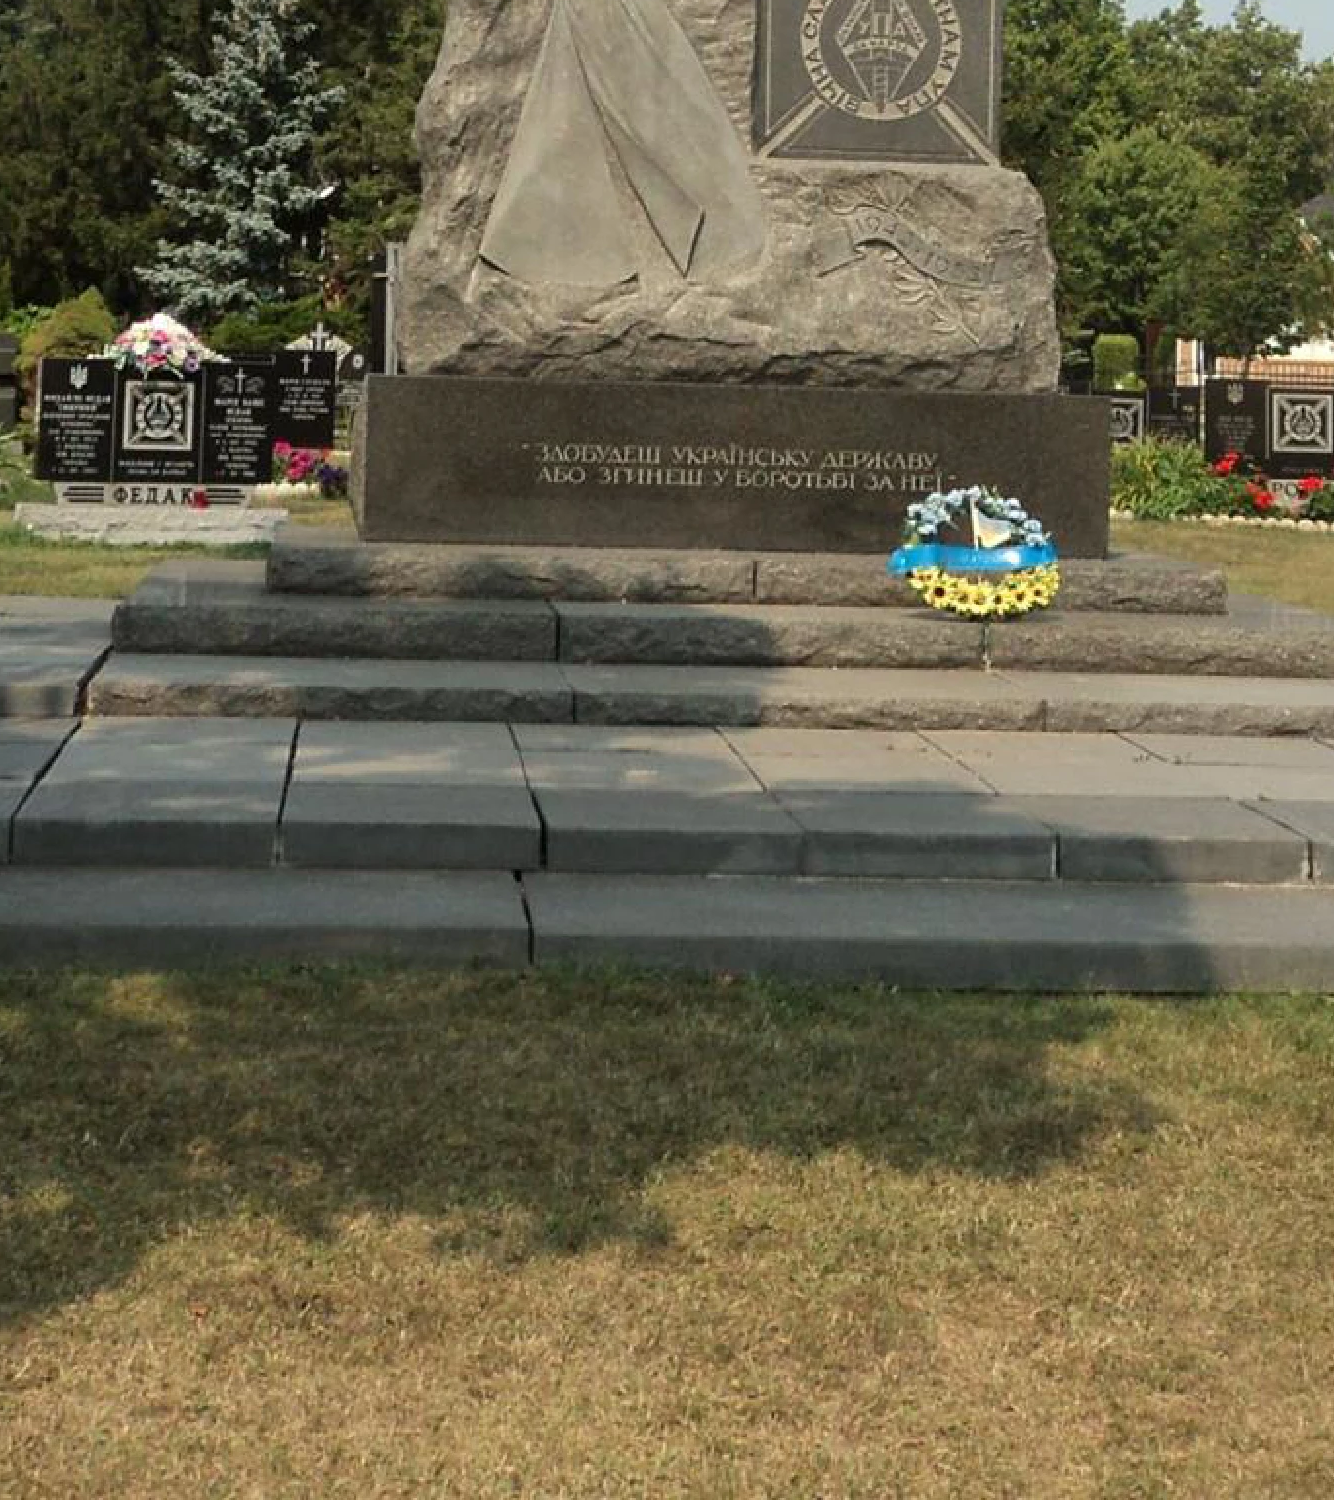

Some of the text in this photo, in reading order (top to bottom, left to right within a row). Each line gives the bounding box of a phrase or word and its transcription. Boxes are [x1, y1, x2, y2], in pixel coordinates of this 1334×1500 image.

[859, 13, 906, 37] УПА
[672, 442, 815, 467] УКРАЇНСЬКУ
[821, 450, 938, 470] ДЕРЖАВУ
[538, 466, 586, 484] АБО
[598, 467, 703, 485] ЗГИНЕШ
[713, 468, 728, 485] У
[863, 472, 895, 491] ЗА
[113, 486, 197, 505] ФЕДАК
